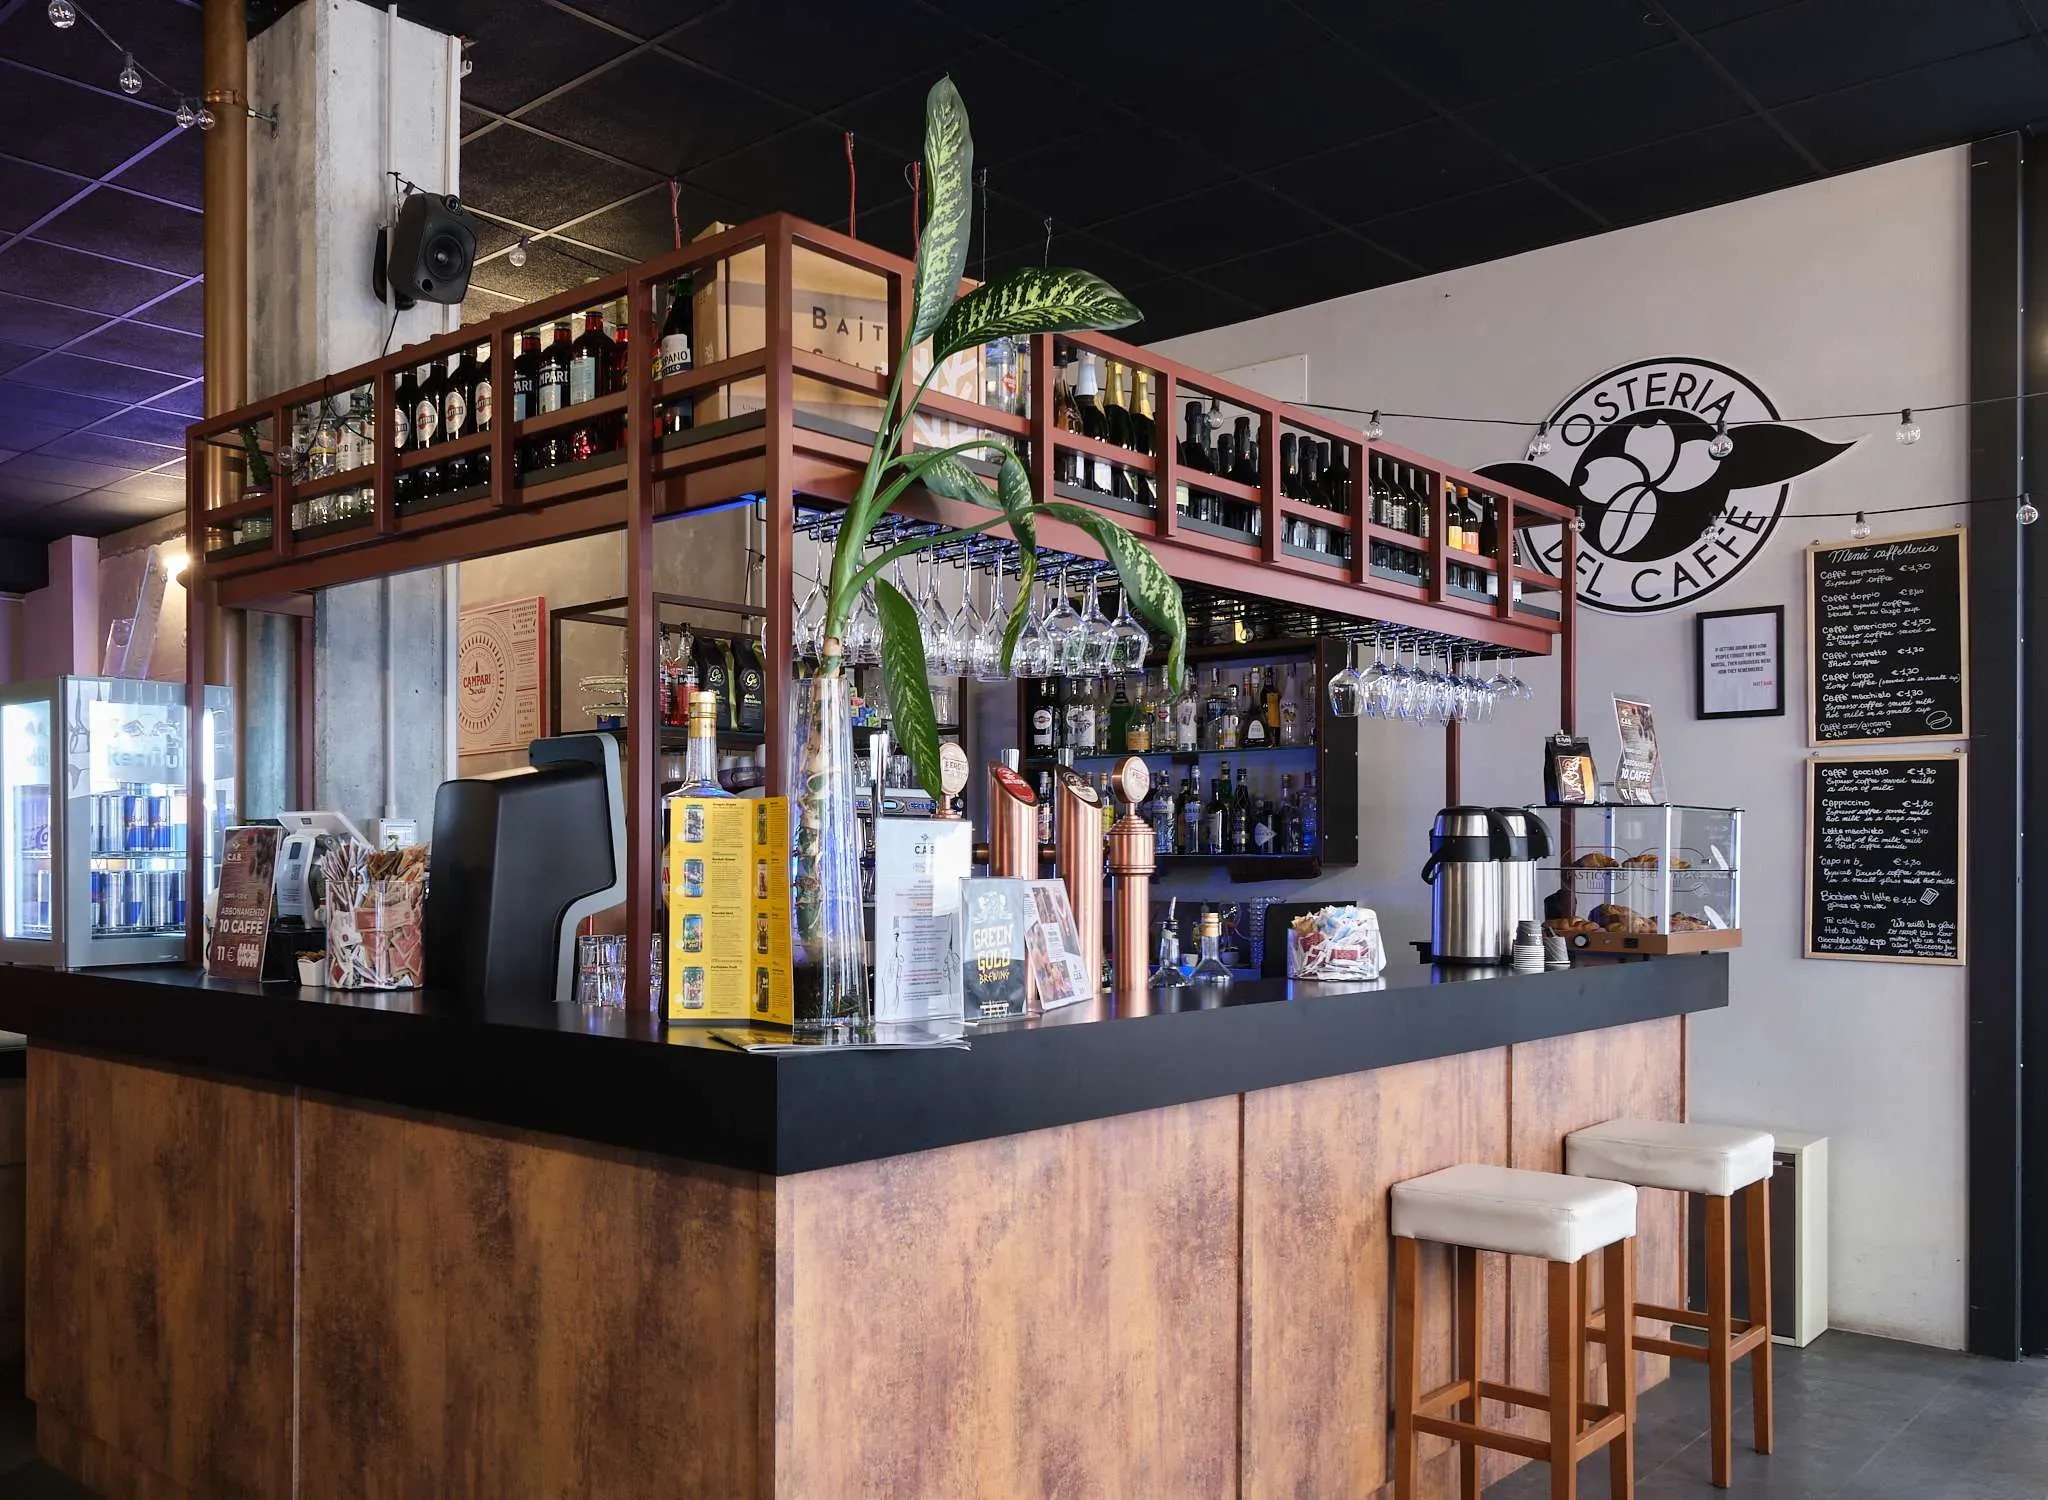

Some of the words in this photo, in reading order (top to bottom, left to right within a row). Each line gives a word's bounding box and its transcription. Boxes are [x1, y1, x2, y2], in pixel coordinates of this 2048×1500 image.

[1561, 372, 1736, 447] OSTERIA
[1543, 539, 1604, 598] DEL
[1851, 593, 1880, 601] doppio
[463, 674, 491, 688] CAMPARI
[1822, 799, 1870, 809] Cappuccino
[221, 907, 265, 917] ABBONAMENTO
[220, 919, 228, 933] 10
[231, 917, 263, 935] CAFFÈ
[973, 924, 1014, 951] GREEN
[977, 947, 1010, 973] GOLD
